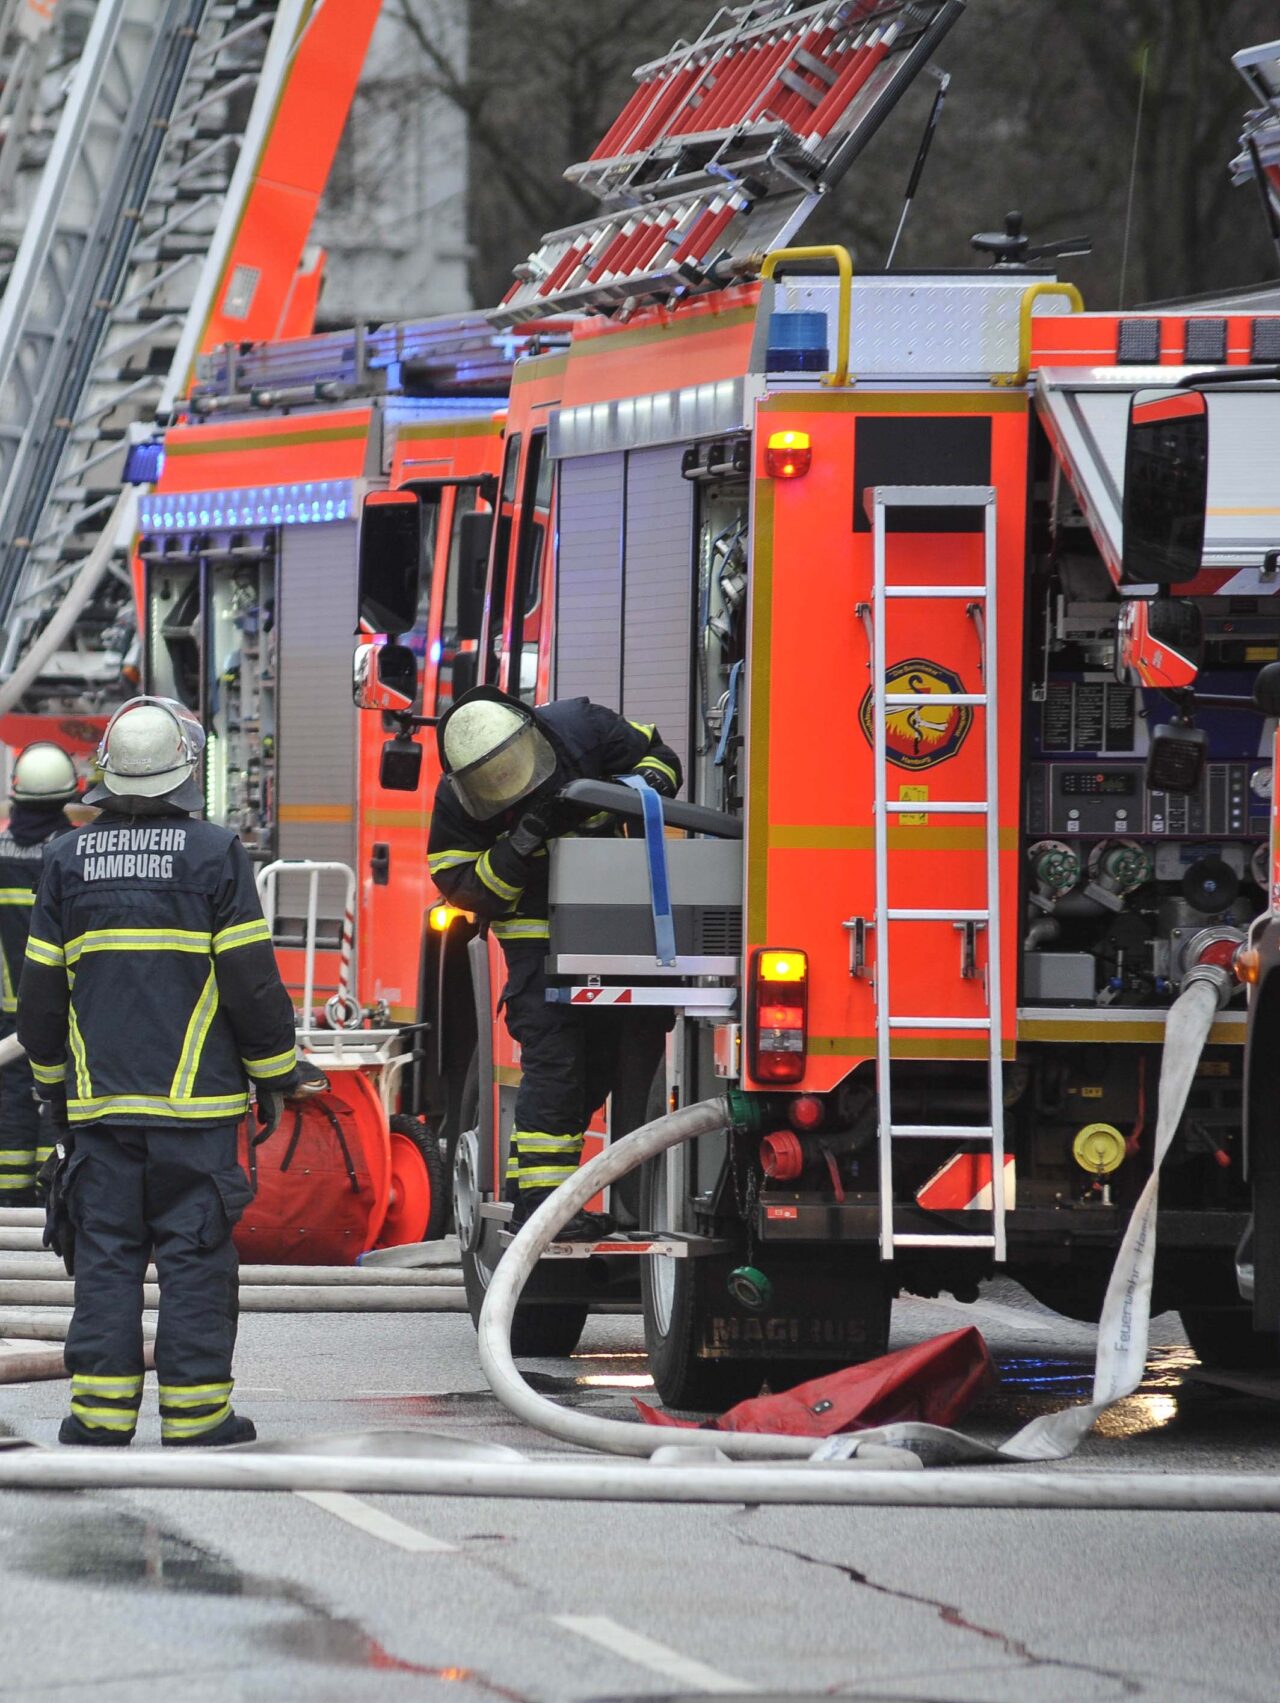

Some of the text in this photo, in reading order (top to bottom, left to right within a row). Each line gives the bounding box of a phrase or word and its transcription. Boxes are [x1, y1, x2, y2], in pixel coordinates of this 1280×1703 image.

[75, 828, 187, 856] FEUERWEHR
[83, 853, 174, 882] HAMBURG
[1114, 1268, 1140, 1353] Feuerwehr
